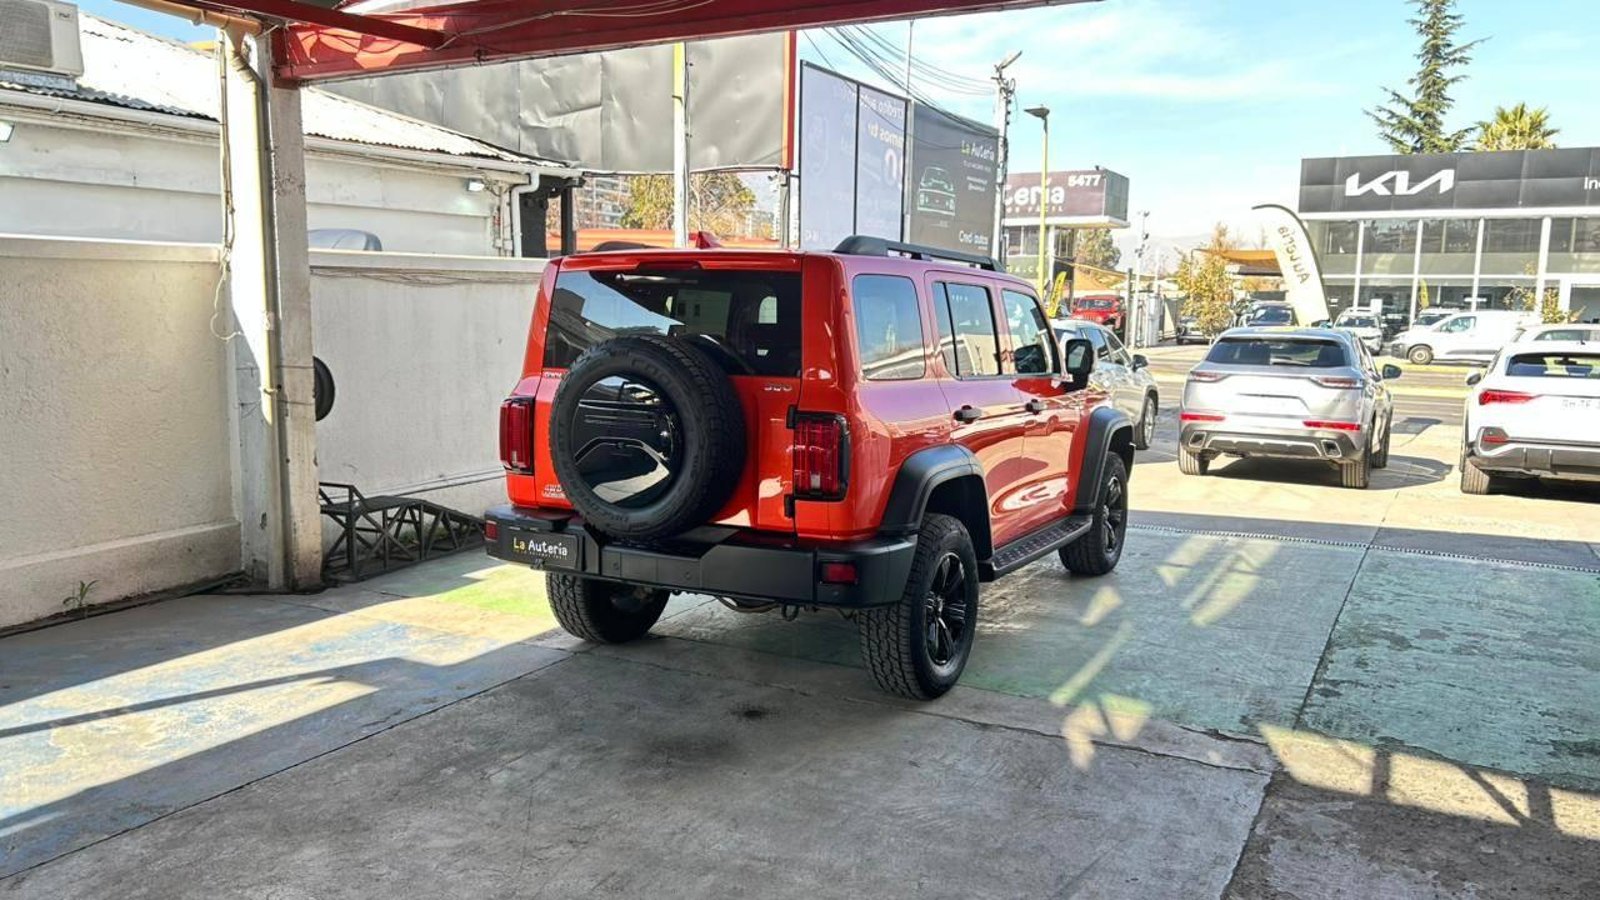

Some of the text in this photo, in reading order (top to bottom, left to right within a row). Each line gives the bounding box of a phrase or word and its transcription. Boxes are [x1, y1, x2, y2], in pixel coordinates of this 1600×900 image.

[961, 139, 971, 156] La
[1345, 169, 1455, 196] KIA
[513, 537, 526, 550] La
